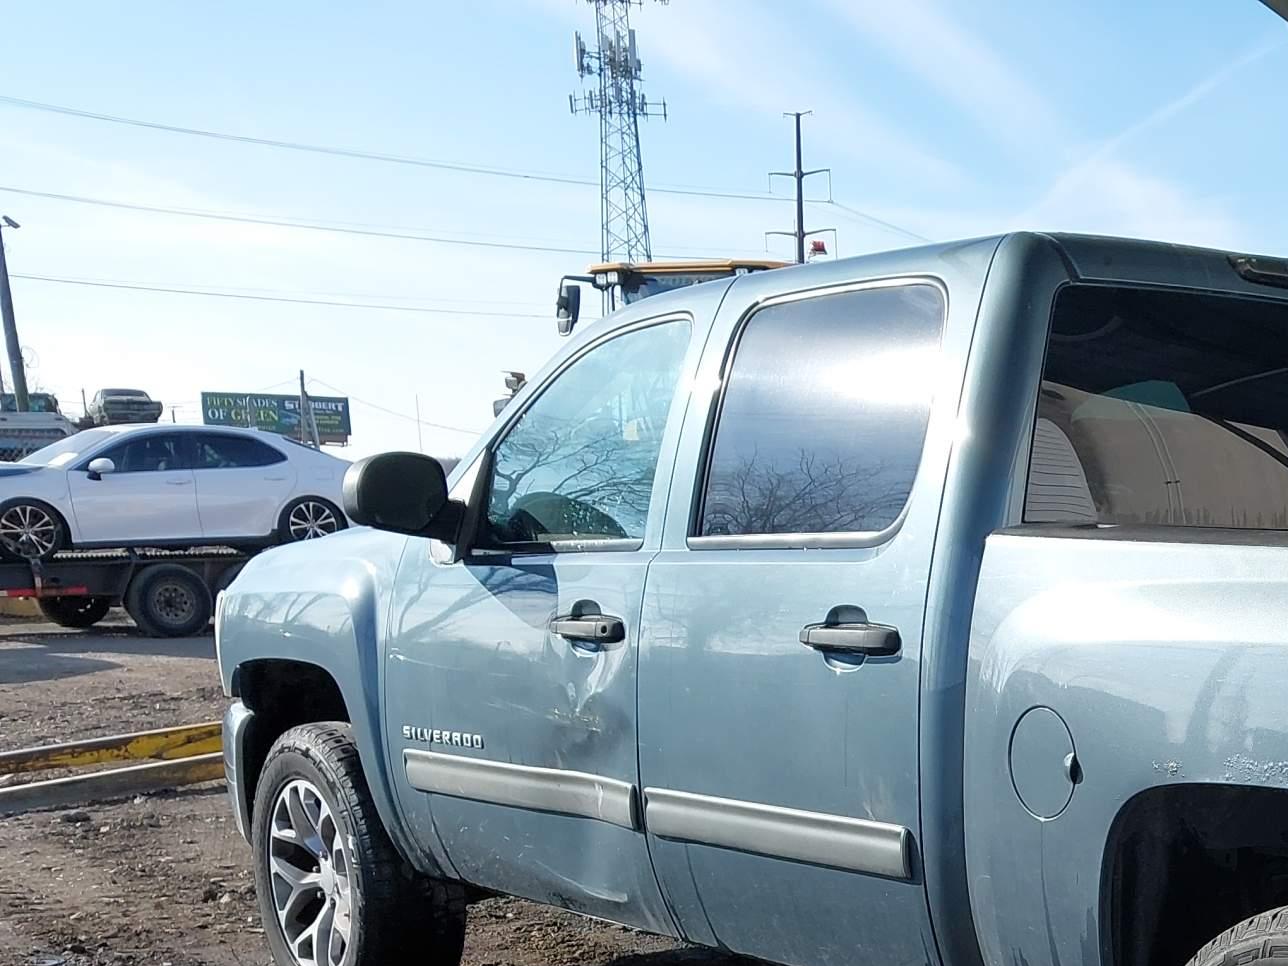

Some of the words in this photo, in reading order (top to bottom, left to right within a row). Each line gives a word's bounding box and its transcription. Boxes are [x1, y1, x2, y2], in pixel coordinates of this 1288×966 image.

[207, 396, 234, 407] FIFTY
[207, 408, 226, 420] OF
[402, 725, 483, 748] SILVERADO
